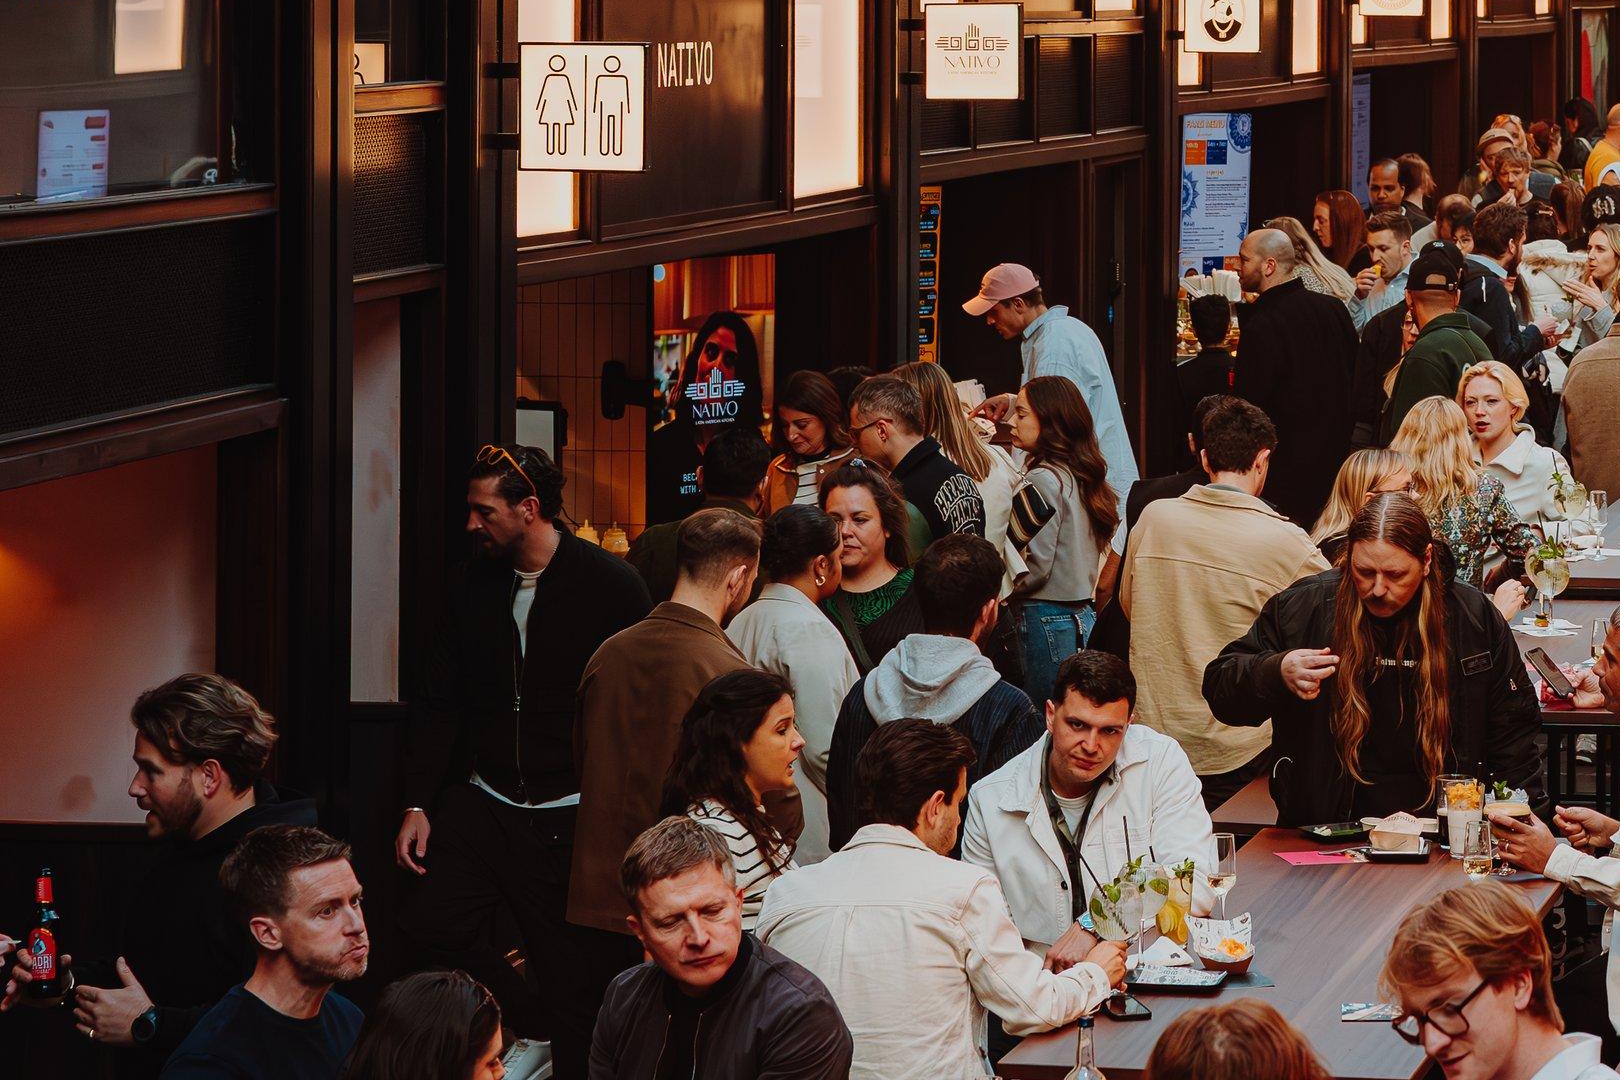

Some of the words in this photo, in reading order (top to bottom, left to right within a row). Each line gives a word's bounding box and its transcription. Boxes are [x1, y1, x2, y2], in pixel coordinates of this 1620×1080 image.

[657, 40, 713, 88] NATIVO
[944, 55, 1001, 70] NATIVO
[692, 400, 739, 419] NATIVO
[682, 473, 697, 482] BEC
[32, 953, 53, 971] ADRÍ
